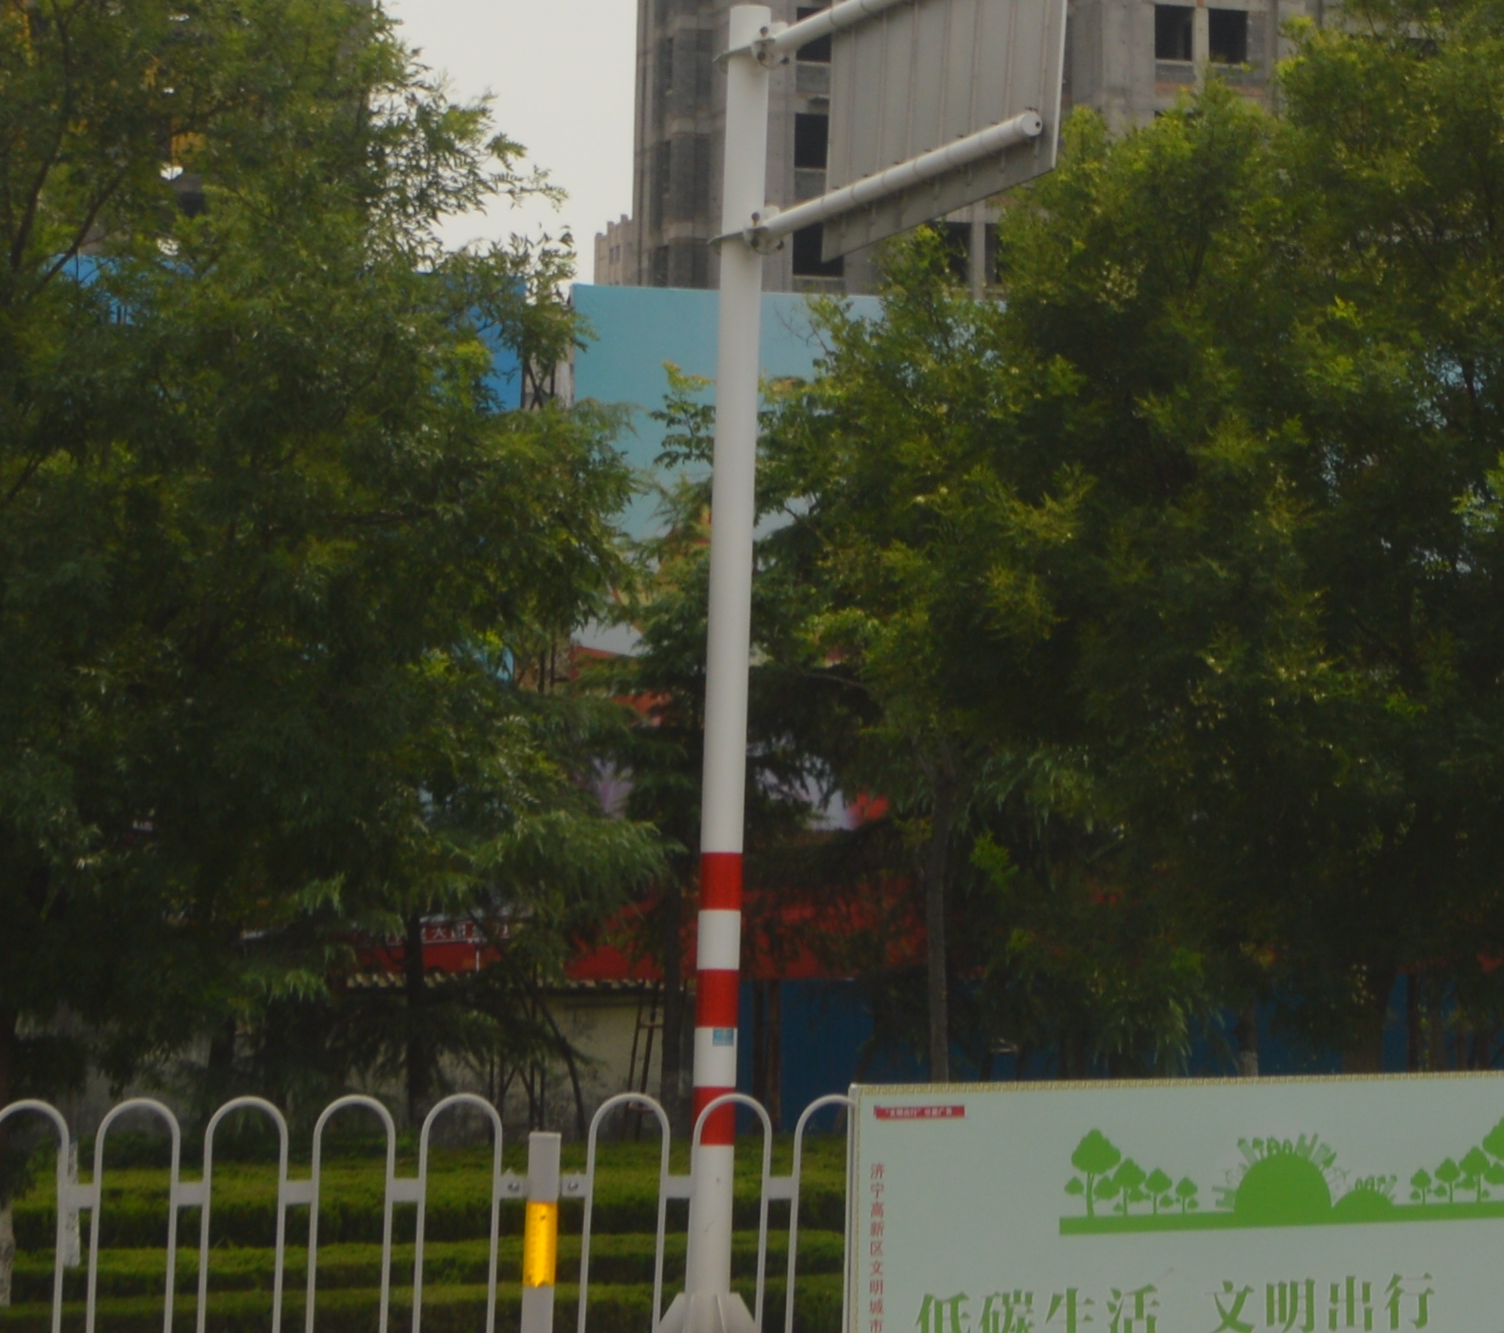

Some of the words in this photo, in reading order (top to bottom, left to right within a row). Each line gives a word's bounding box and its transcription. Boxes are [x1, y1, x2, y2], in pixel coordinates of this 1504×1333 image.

[870, 1162, 885, 1333] 济宁高新区文明城市
[915, 1284, 1162, 1333] 低碳生活
[1205, 1274, 1433, 1333] 文明出行
